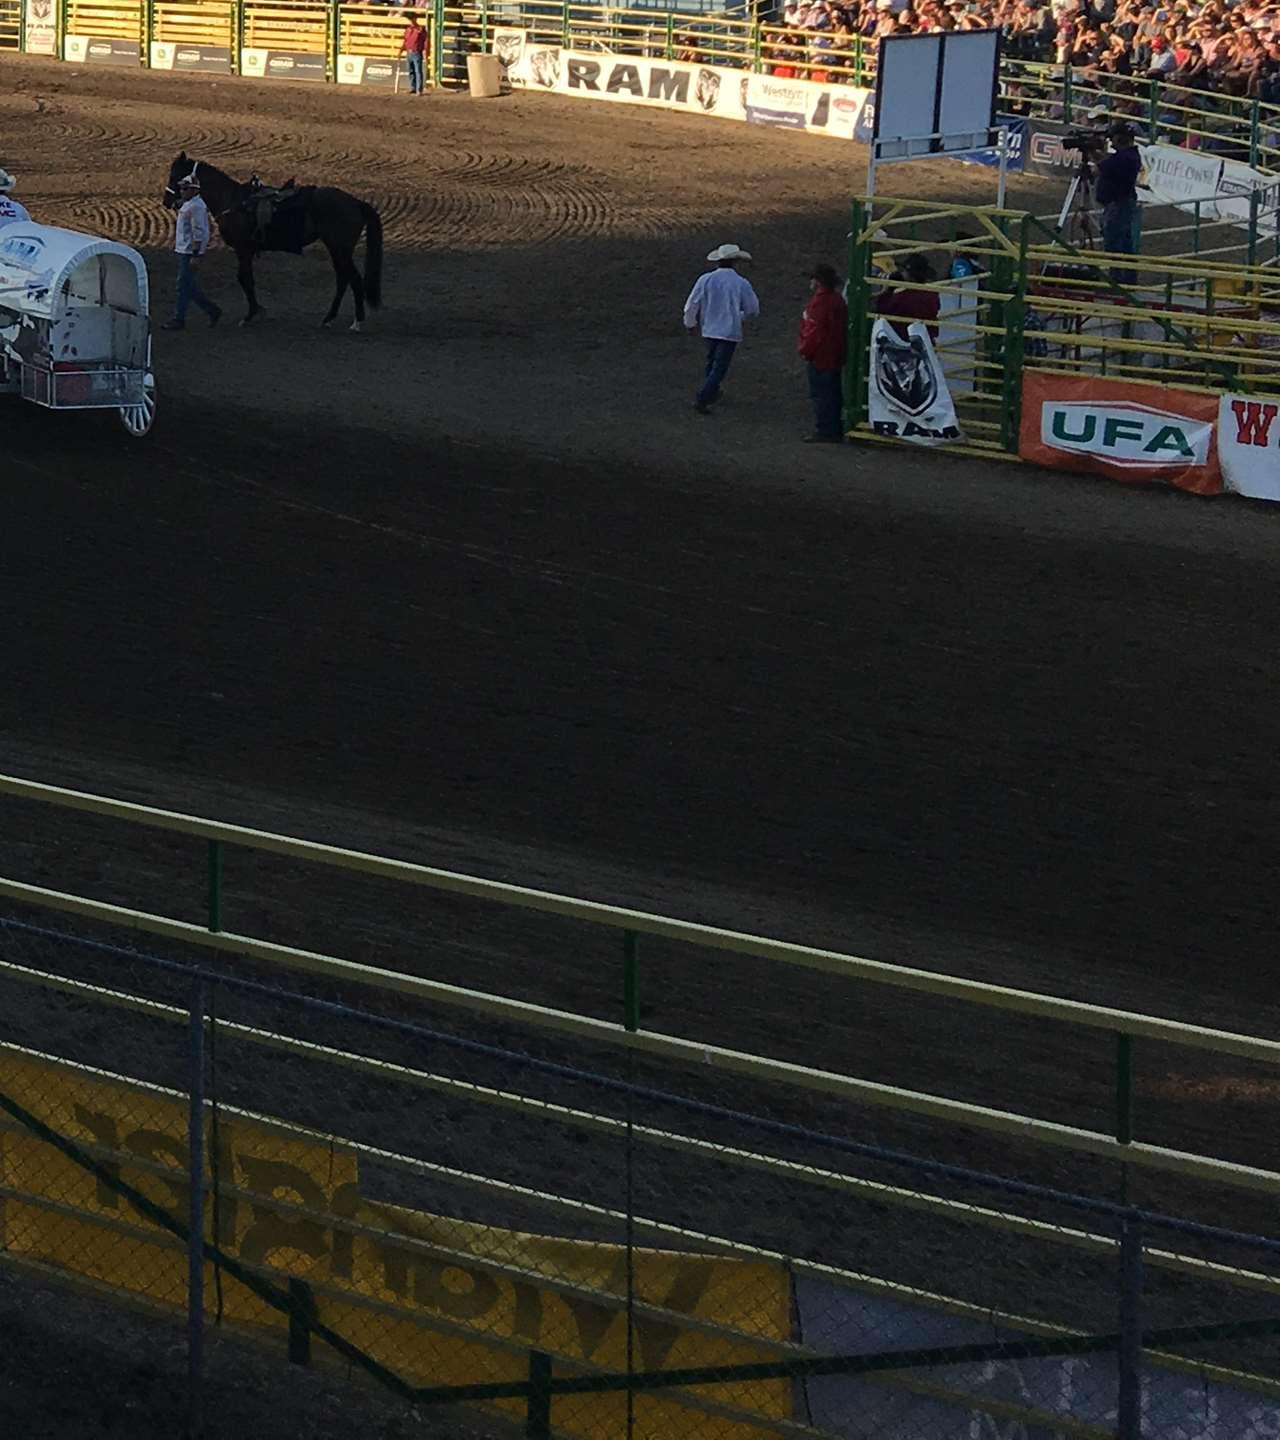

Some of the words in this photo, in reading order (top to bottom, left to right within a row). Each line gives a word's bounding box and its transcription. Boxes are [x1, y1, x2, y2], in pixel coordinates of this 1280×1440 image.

[567, 58, 691, 104] RAM
[873, 420, 960, 441] RAM
[1051, 410, 1195, 457] UFA
